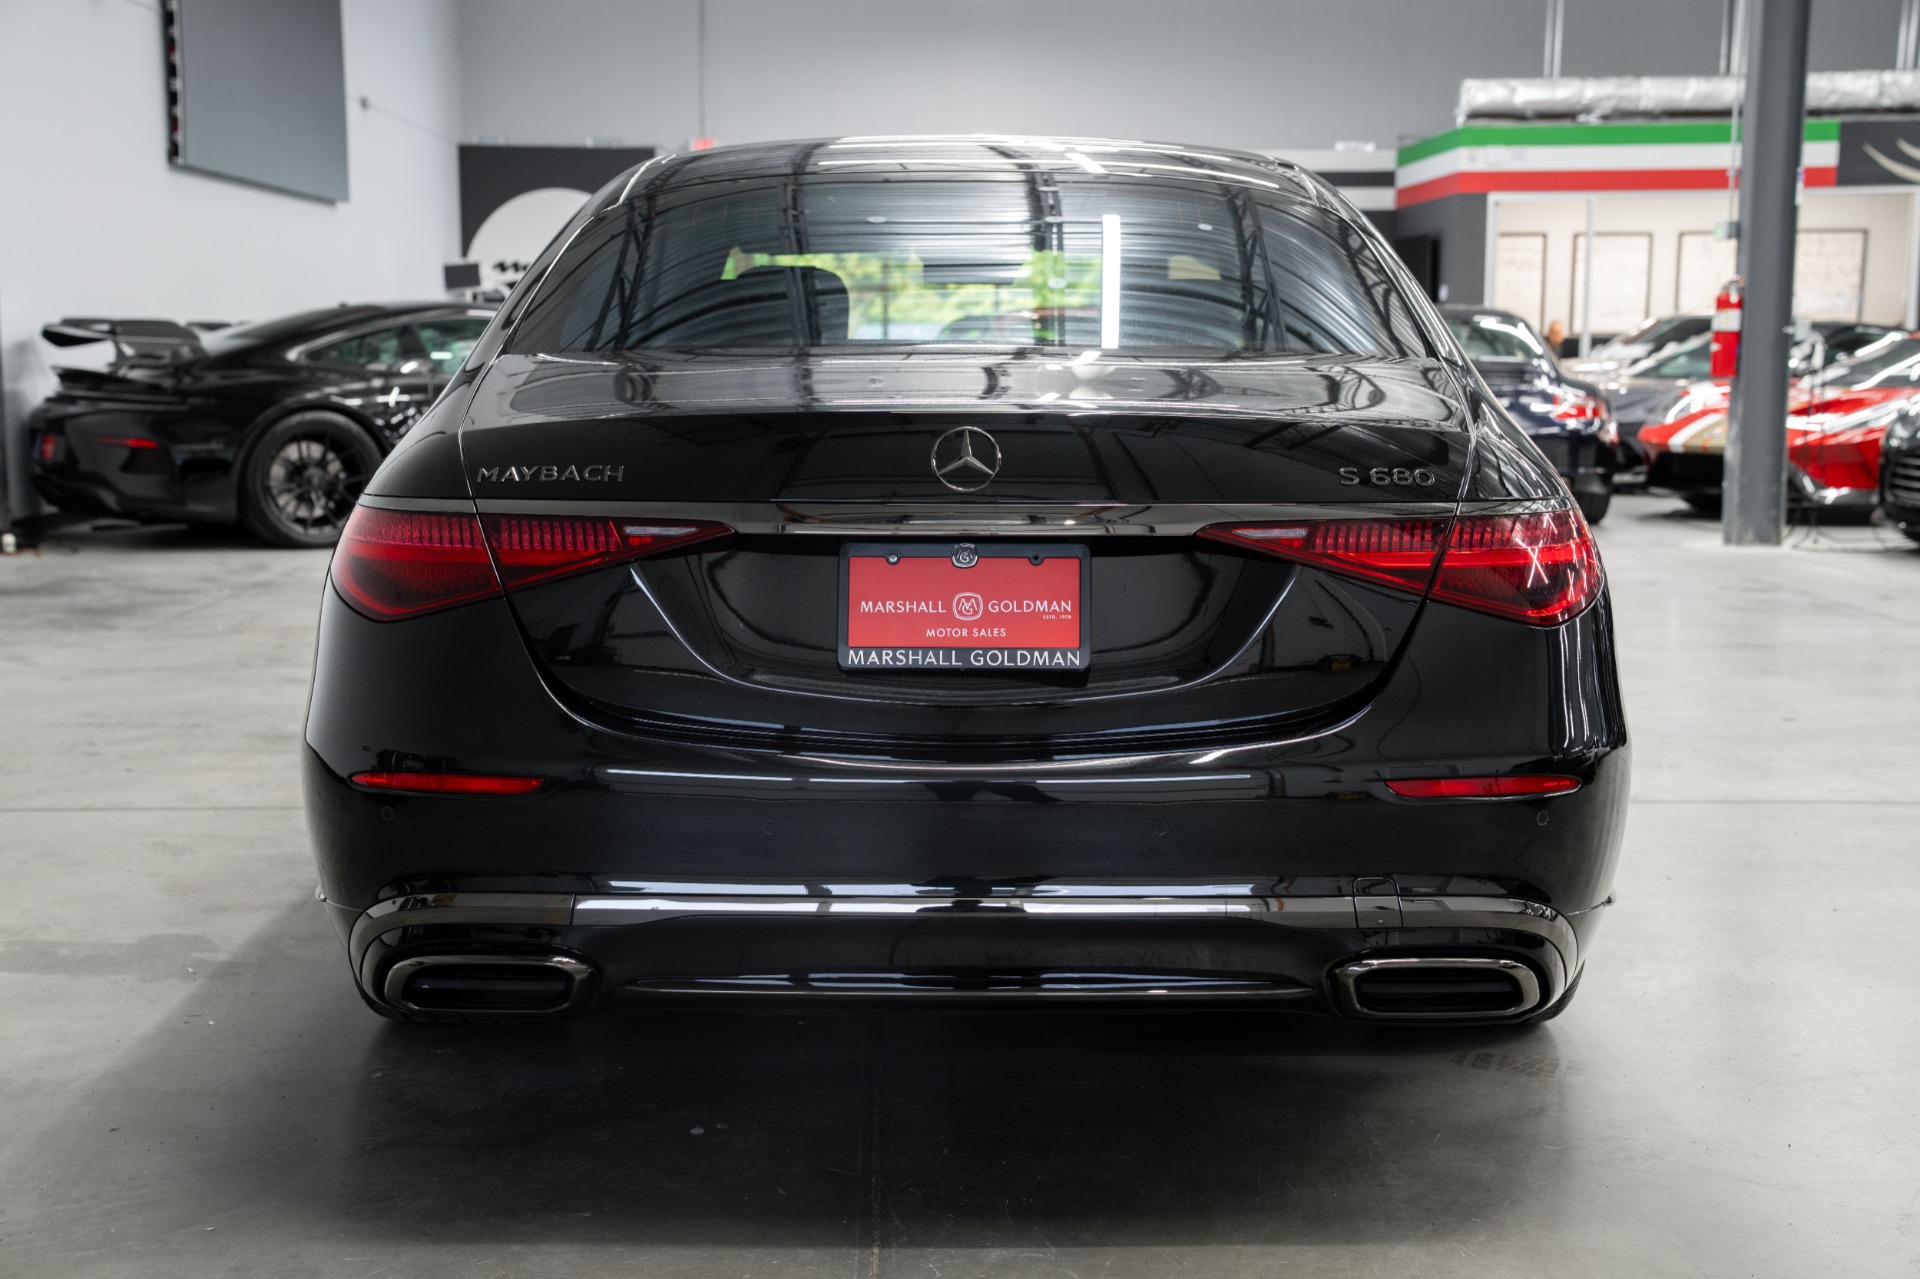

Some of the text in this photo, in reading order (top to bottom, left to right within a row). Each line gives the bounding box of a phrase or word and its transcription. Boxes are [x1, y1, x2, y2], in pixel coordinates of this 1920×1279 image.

[476, 464, 625, 484] MAYBACH
[1339, 467, 1435, 487] S 680
[860, 600, 947, 613] MARSHALL
[987, 600, 1072, 613] GOLDMAN
[925, 627, 1006, 638] MOTOR SALES
[848, 650, 1081, 667] MARSHALL GOLDMAN
